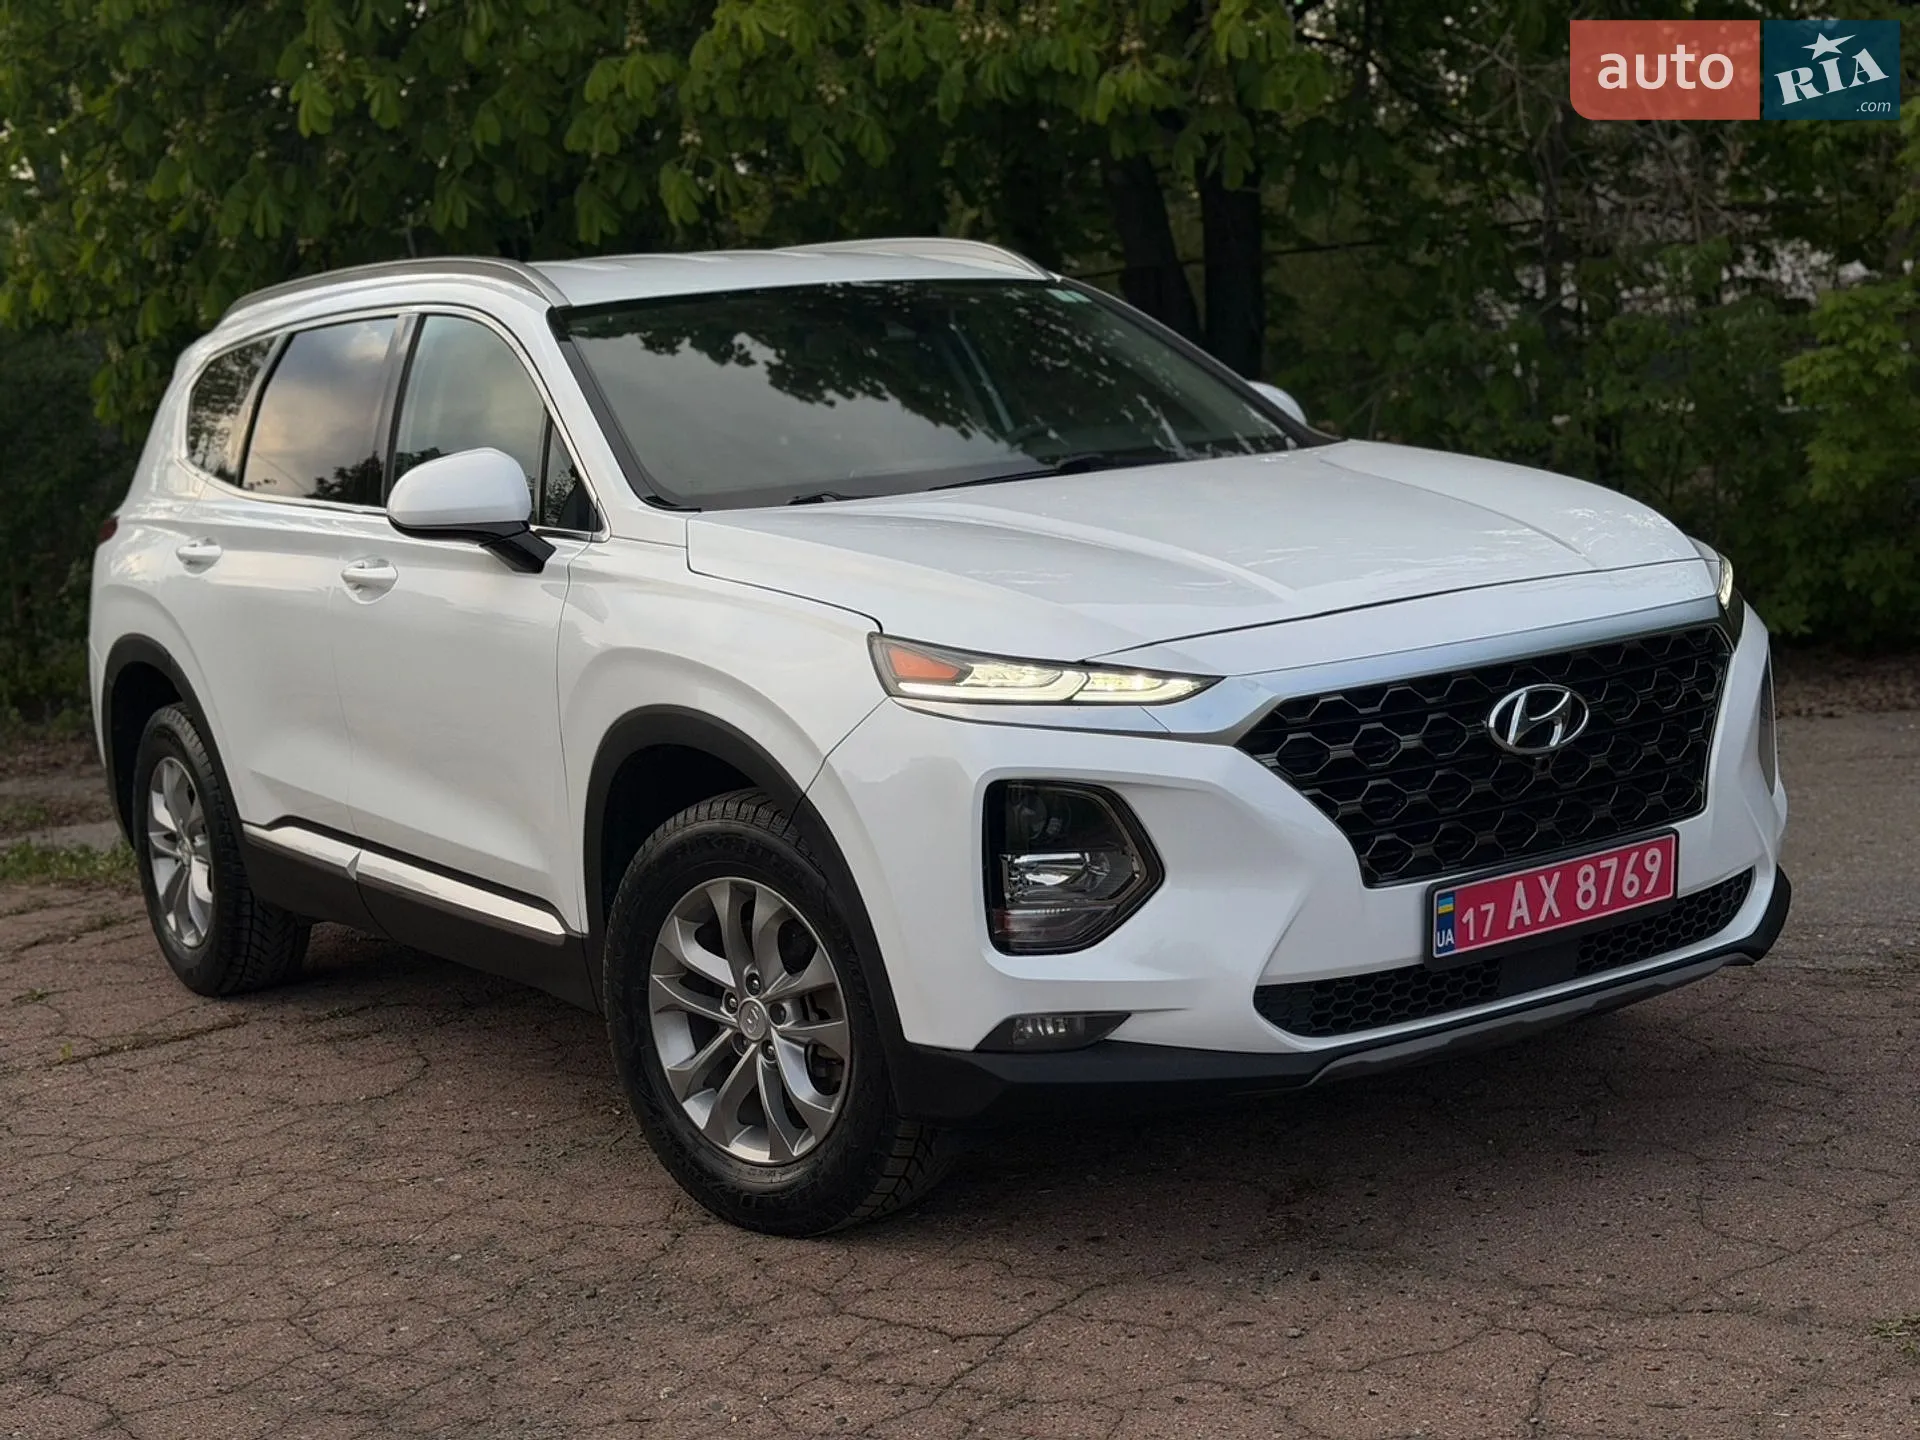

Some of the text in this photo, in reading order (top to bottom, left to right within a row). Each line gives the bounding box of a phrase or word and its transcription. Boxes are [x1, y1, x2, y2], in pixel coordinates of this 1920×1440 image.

[1462, 848, 1662, 940] 17 AX 8769
[1437, 930, 1454, 948] UA
